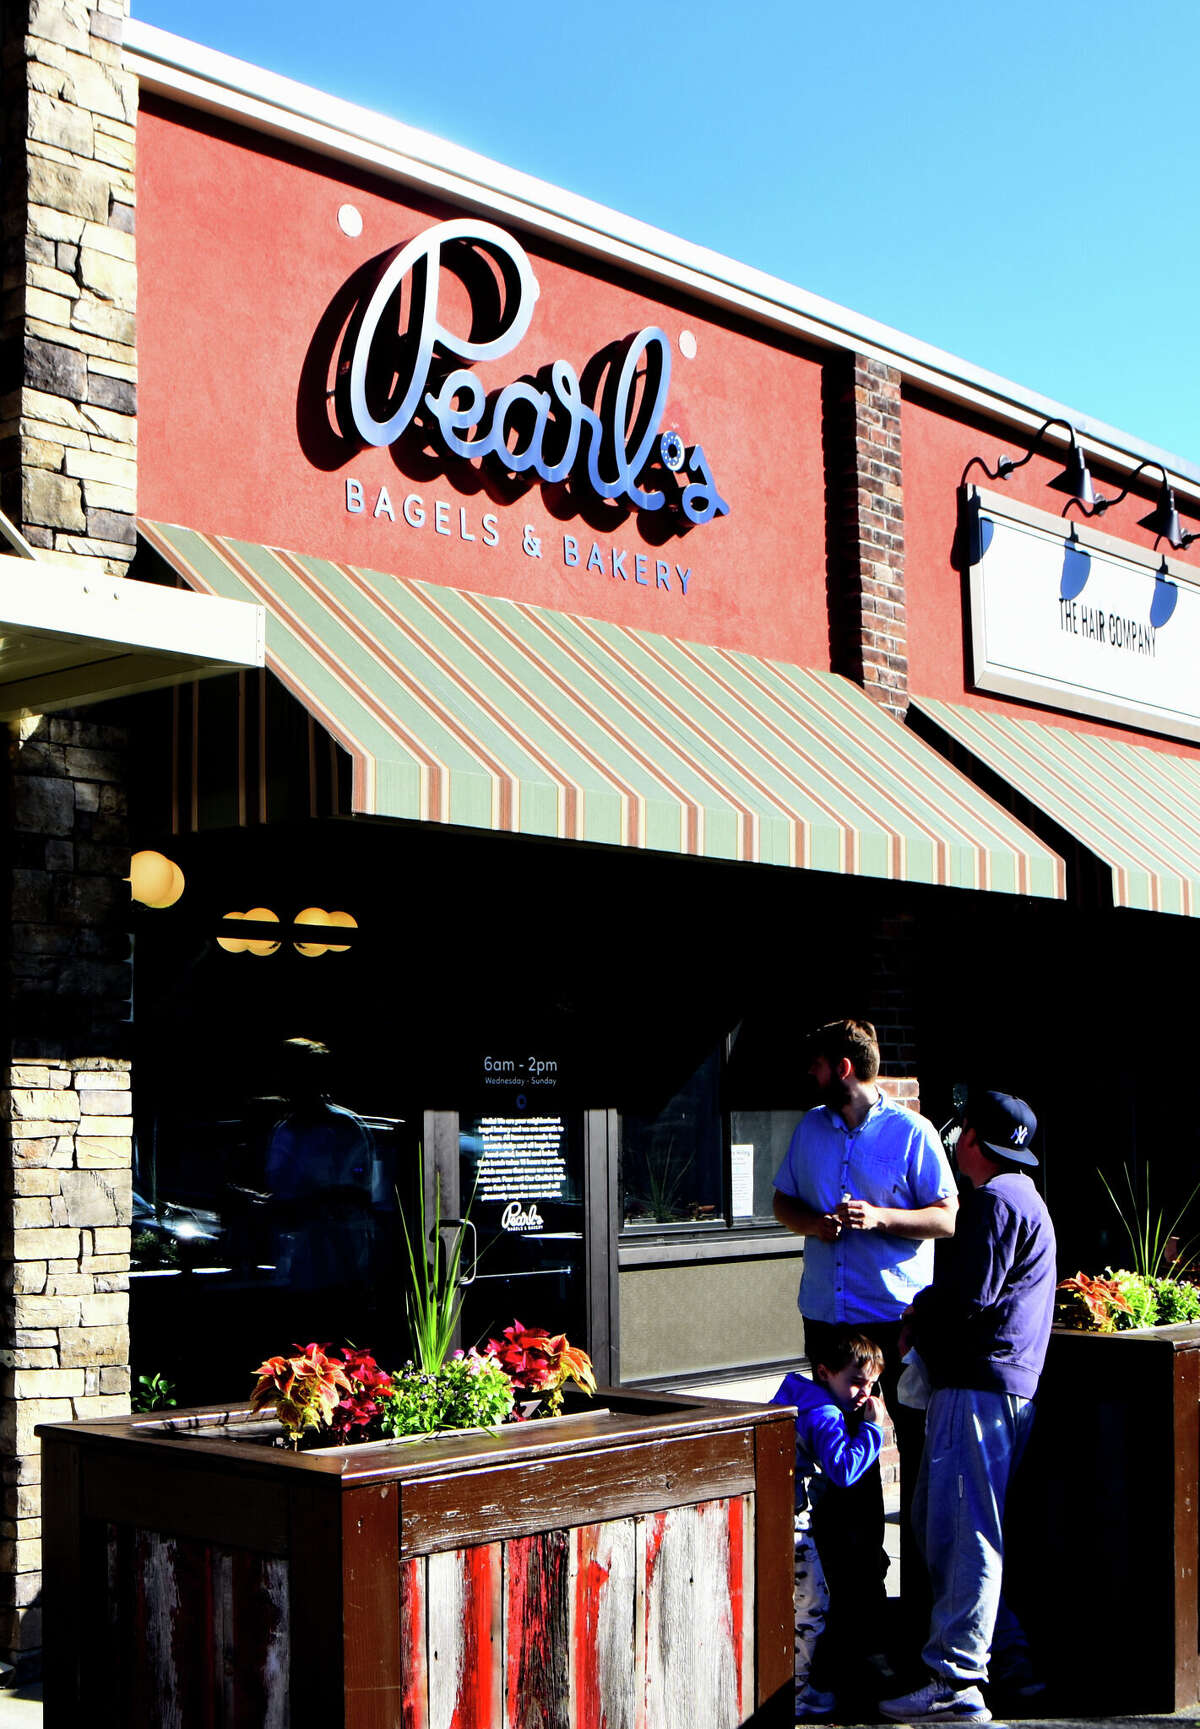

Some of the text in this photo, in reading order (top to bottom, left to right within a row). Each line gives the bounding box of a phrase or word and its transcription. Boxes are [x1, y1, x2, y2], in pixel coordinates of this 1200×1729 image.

[345, 478, 693, 596] BAGELS & BAKERY
[1058, 597, 1157, 658] THE HAIR COMPANY
[484, 1056, 514, 1071] 6am
[528, 1056, 558, 1075] 2pm
[485, 1077, 525, 1086] Wednesday
[531, 1076, 557, 1086] Sunday
